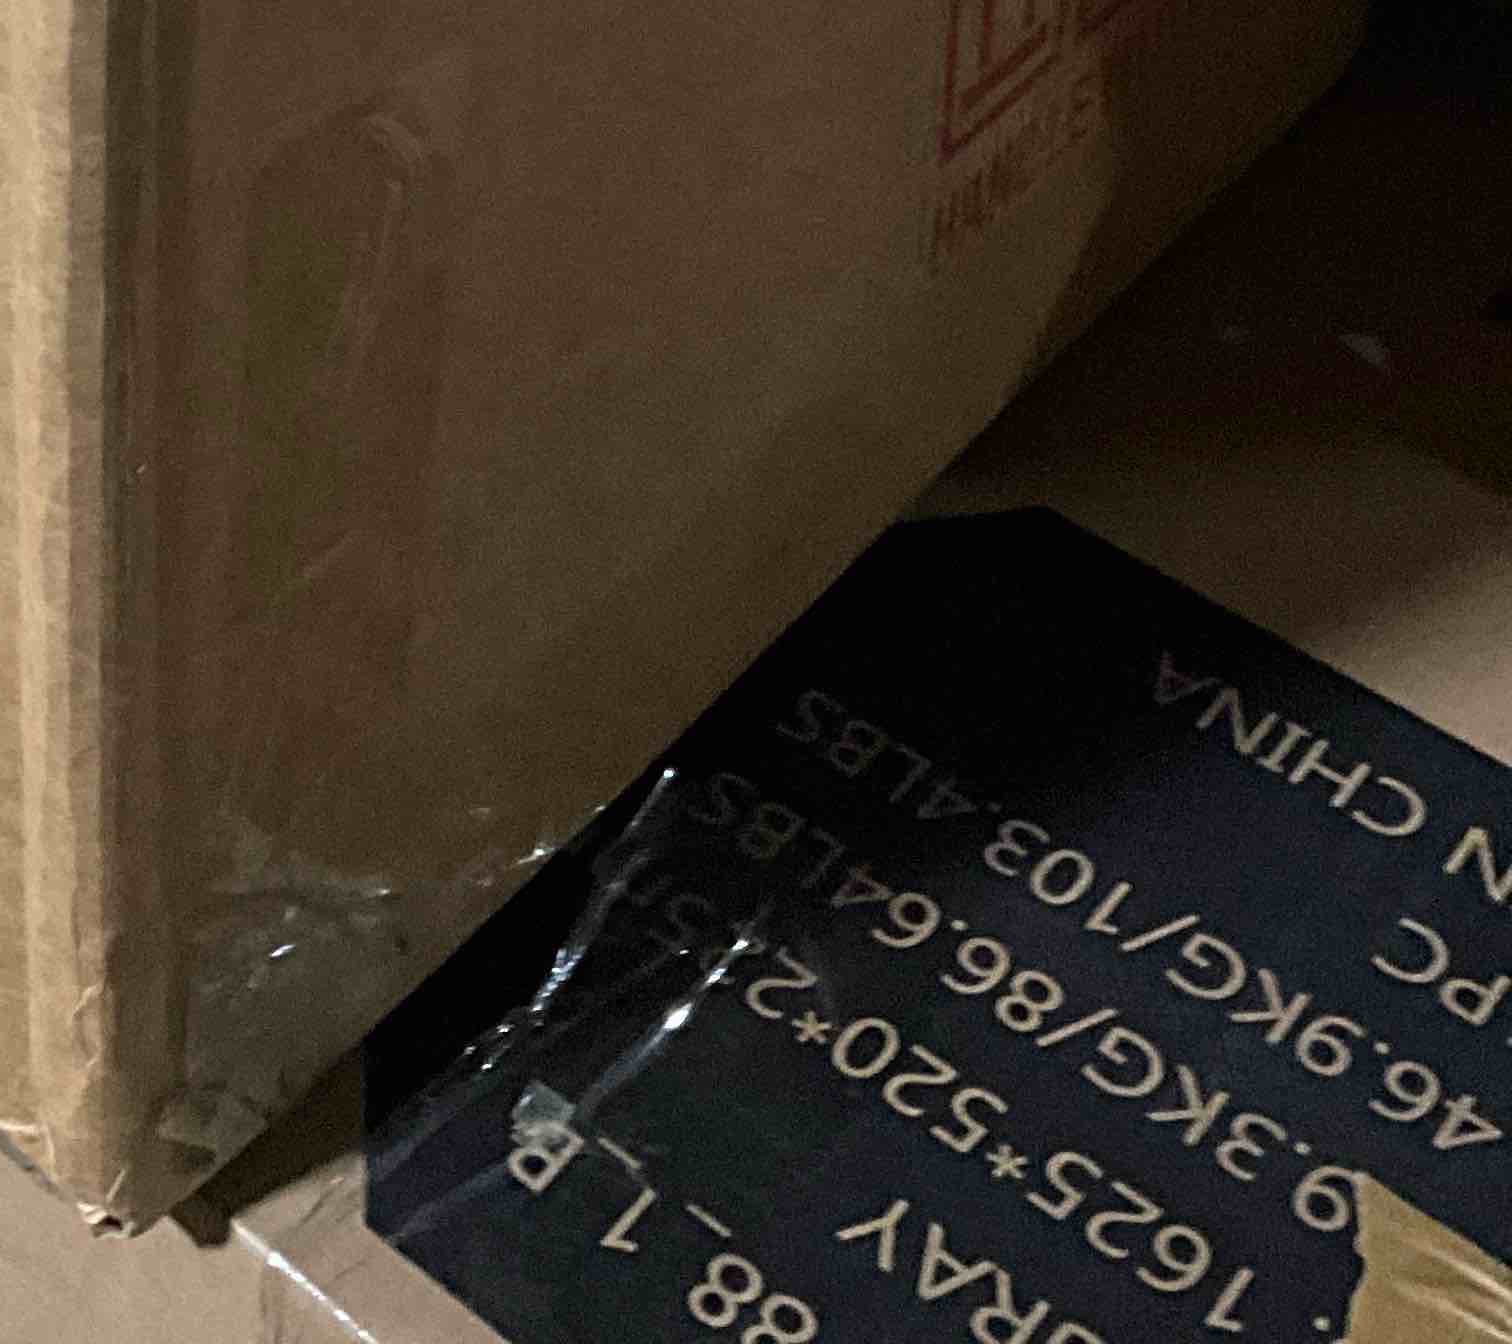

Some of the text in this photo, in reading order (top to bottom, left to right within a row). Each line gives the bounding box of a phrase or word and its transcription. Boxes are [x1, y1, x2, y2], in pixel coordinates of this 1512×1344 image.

[1152, 650, 1427, 837] CHINA
[687, 770, 1354, 1232] 9.3KG/86.64LBS
[1368, 916, 1510, 1027] PC
